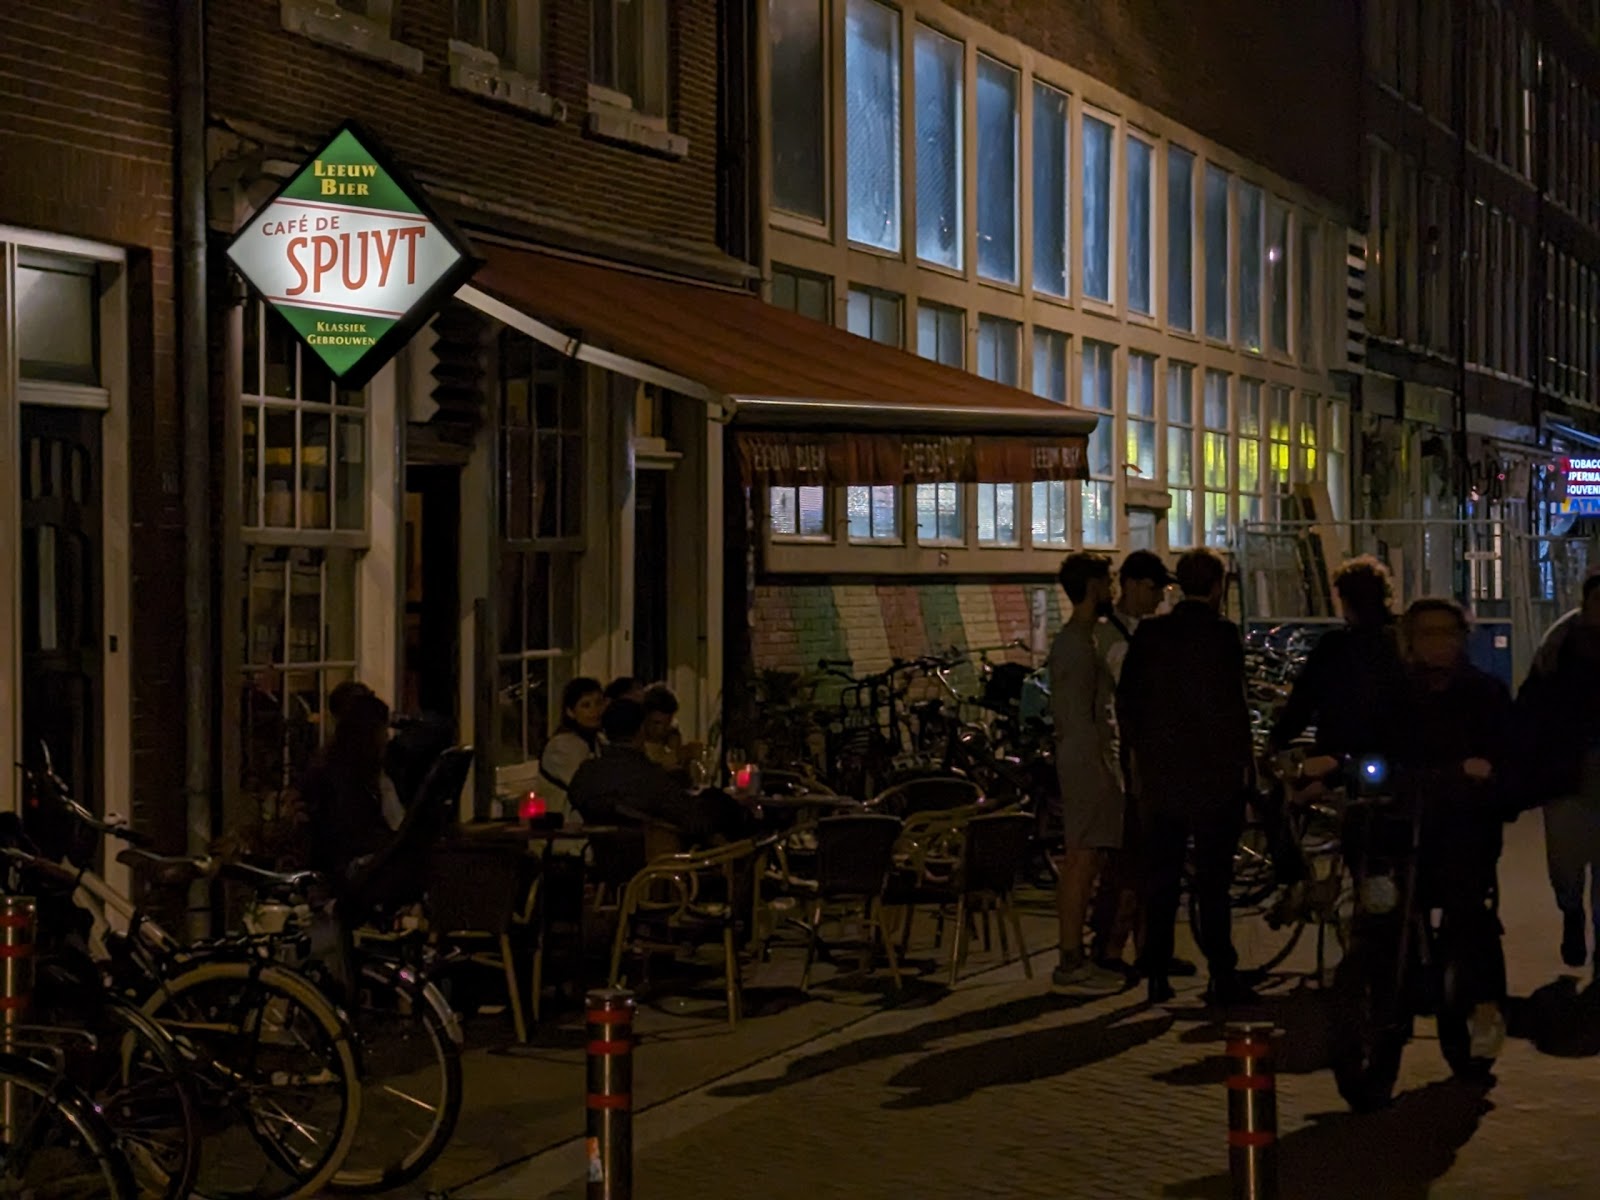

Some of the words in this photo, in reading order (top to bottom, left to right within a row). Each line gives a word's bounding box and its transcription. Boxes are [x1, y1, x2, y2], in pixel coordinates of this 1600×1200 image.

[314, 160, 378, 178] LEEUW
[321, 178, 370, 196] BIER
[262, 215, 308, 236] CAFÉ
[315, 216, 340, 231] DE
[286, 226, 426, 296] SPUYT
[316, 321, 367, 333] KLASSIEK
[307, 334, 376, 346] GEBROUWEN
